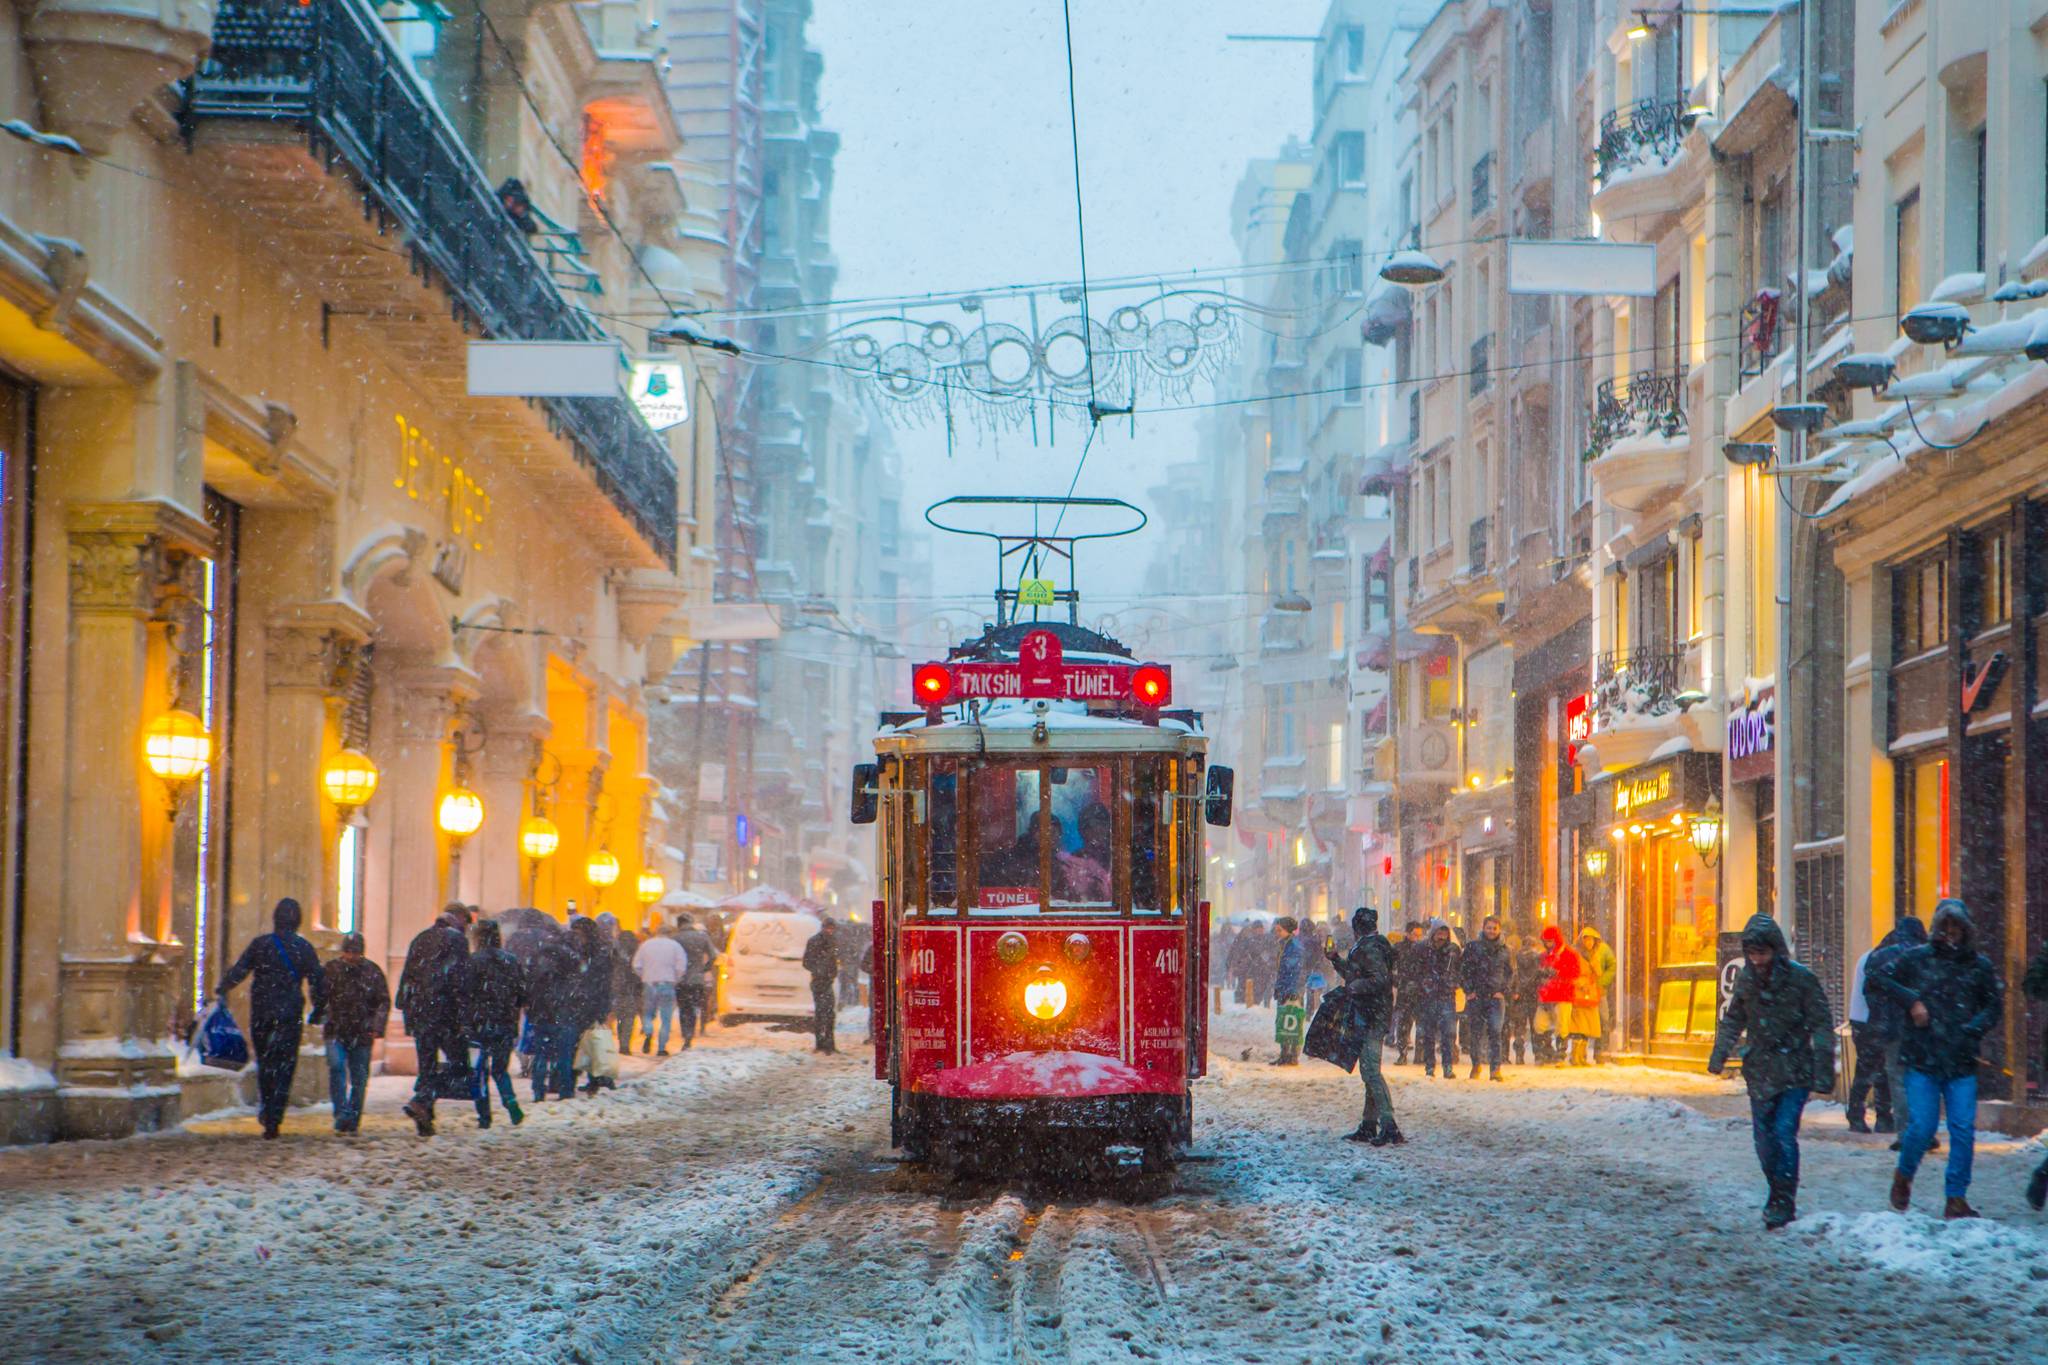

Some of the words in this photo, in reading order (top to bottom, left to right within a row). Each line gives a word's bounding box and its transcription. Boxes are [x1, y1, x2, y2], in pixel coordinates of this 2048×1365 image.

[1035, 635, 1047, 660] 3
[960, 669, 1021, 695] TAKSİM
[1063, 670, 1121, 696] TÜNEL
[986, 891, 1033, 904] TÜNEL
[910, 948, 935, 974] 410
[1155, 948, 1179, 974] 410
